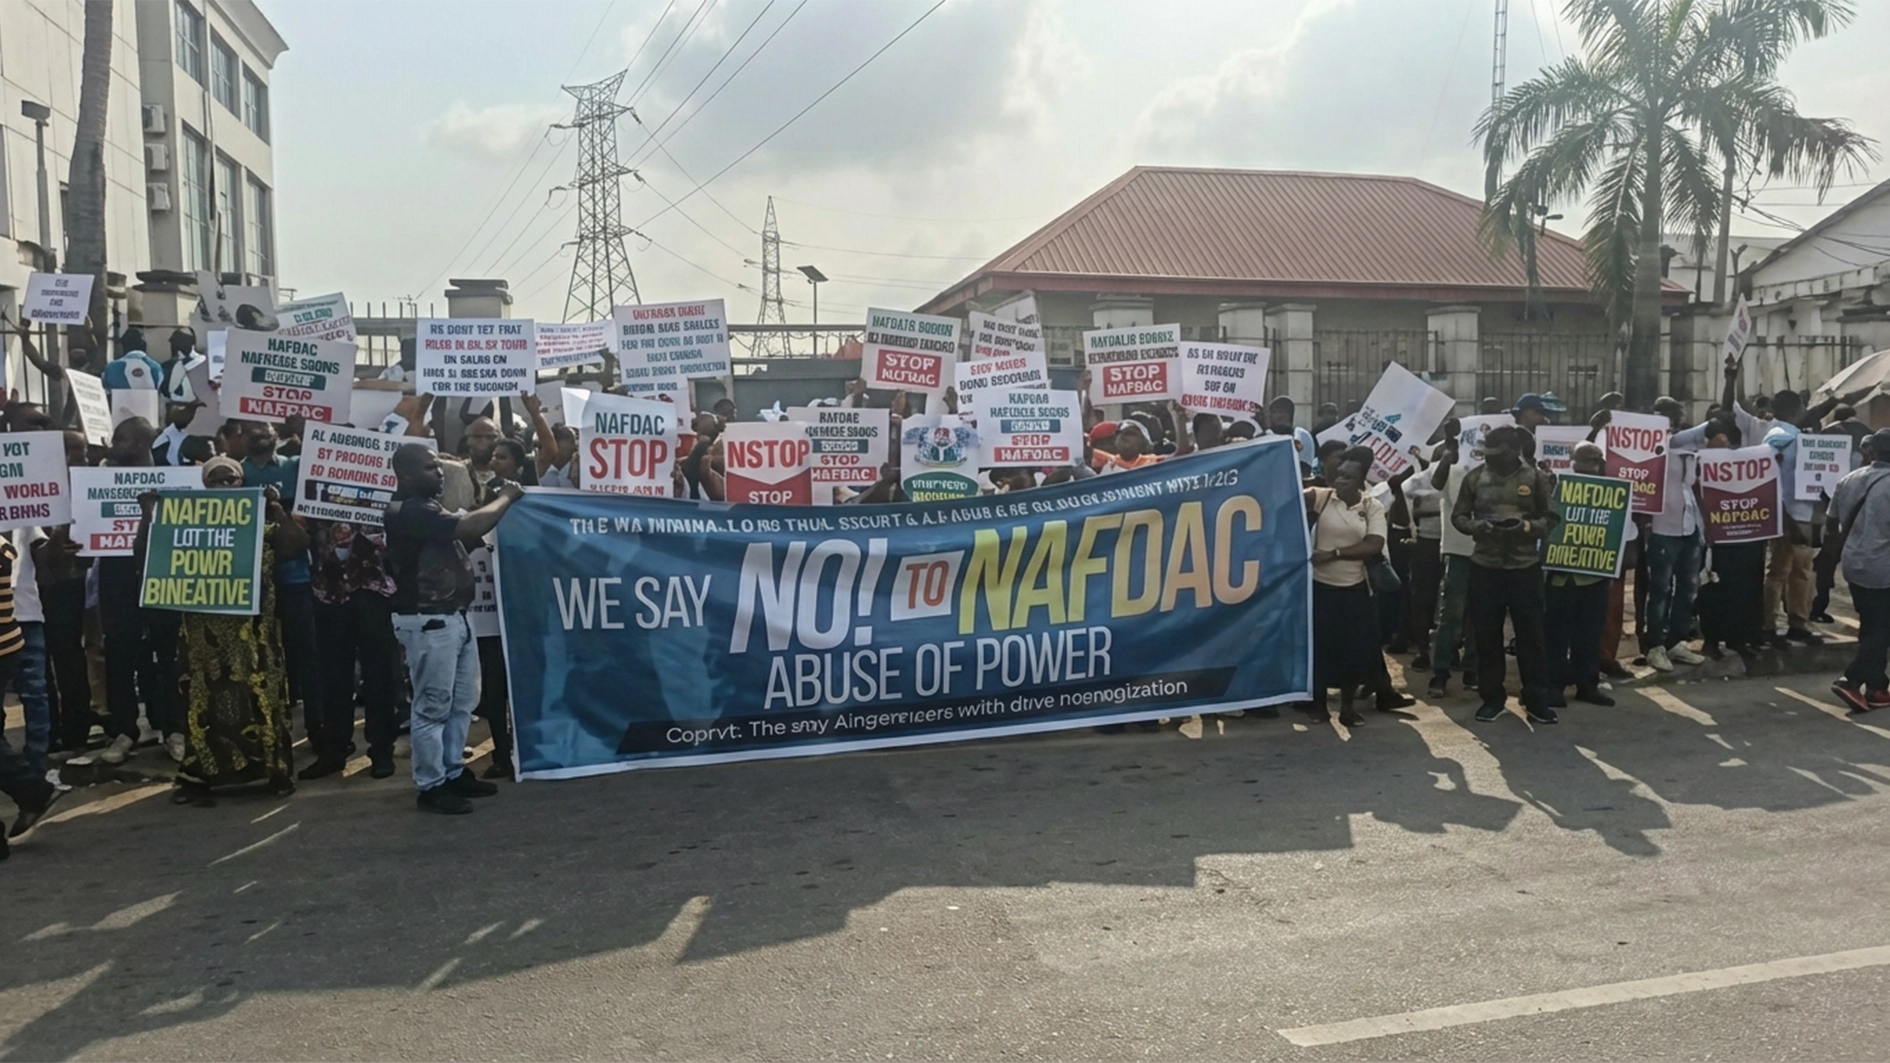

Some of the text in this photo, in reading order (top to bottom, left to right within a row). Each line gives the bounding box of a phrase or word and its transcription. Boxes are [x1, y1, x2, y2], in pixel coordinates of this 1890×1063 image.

[1110, 364, 1160, 382] STOP
[594, 412, 665, 436] NAFDAC
[589, 437, 668, 480] STOP
[727, 439, 810, 469] NSTOP
[114, 472, 165, 485] NAFDAC
[1702, 457, 1772, 482] NSTOP
[748, 490, 793, 505] STOP
[1560, 480, 1626, 510] NAFDAC
[161, 497, 252, 526] NAFDAC
[207, 527, 236, 547] THE
[170, 549, 233, 576] POWR
[552, 577, 625, 631] WE
[634, 574, 712, 630] SAY
[729, 537, 888, 654] NO!
[905, 560, 950, 610] TO
[958, 495, 1263, 635] NAFDAC
[143, 578, 252, 606] BINEATIVE
[763, 625, 1113, 710] ABUSE OF POWER
[748, 720, 787, 737] The
